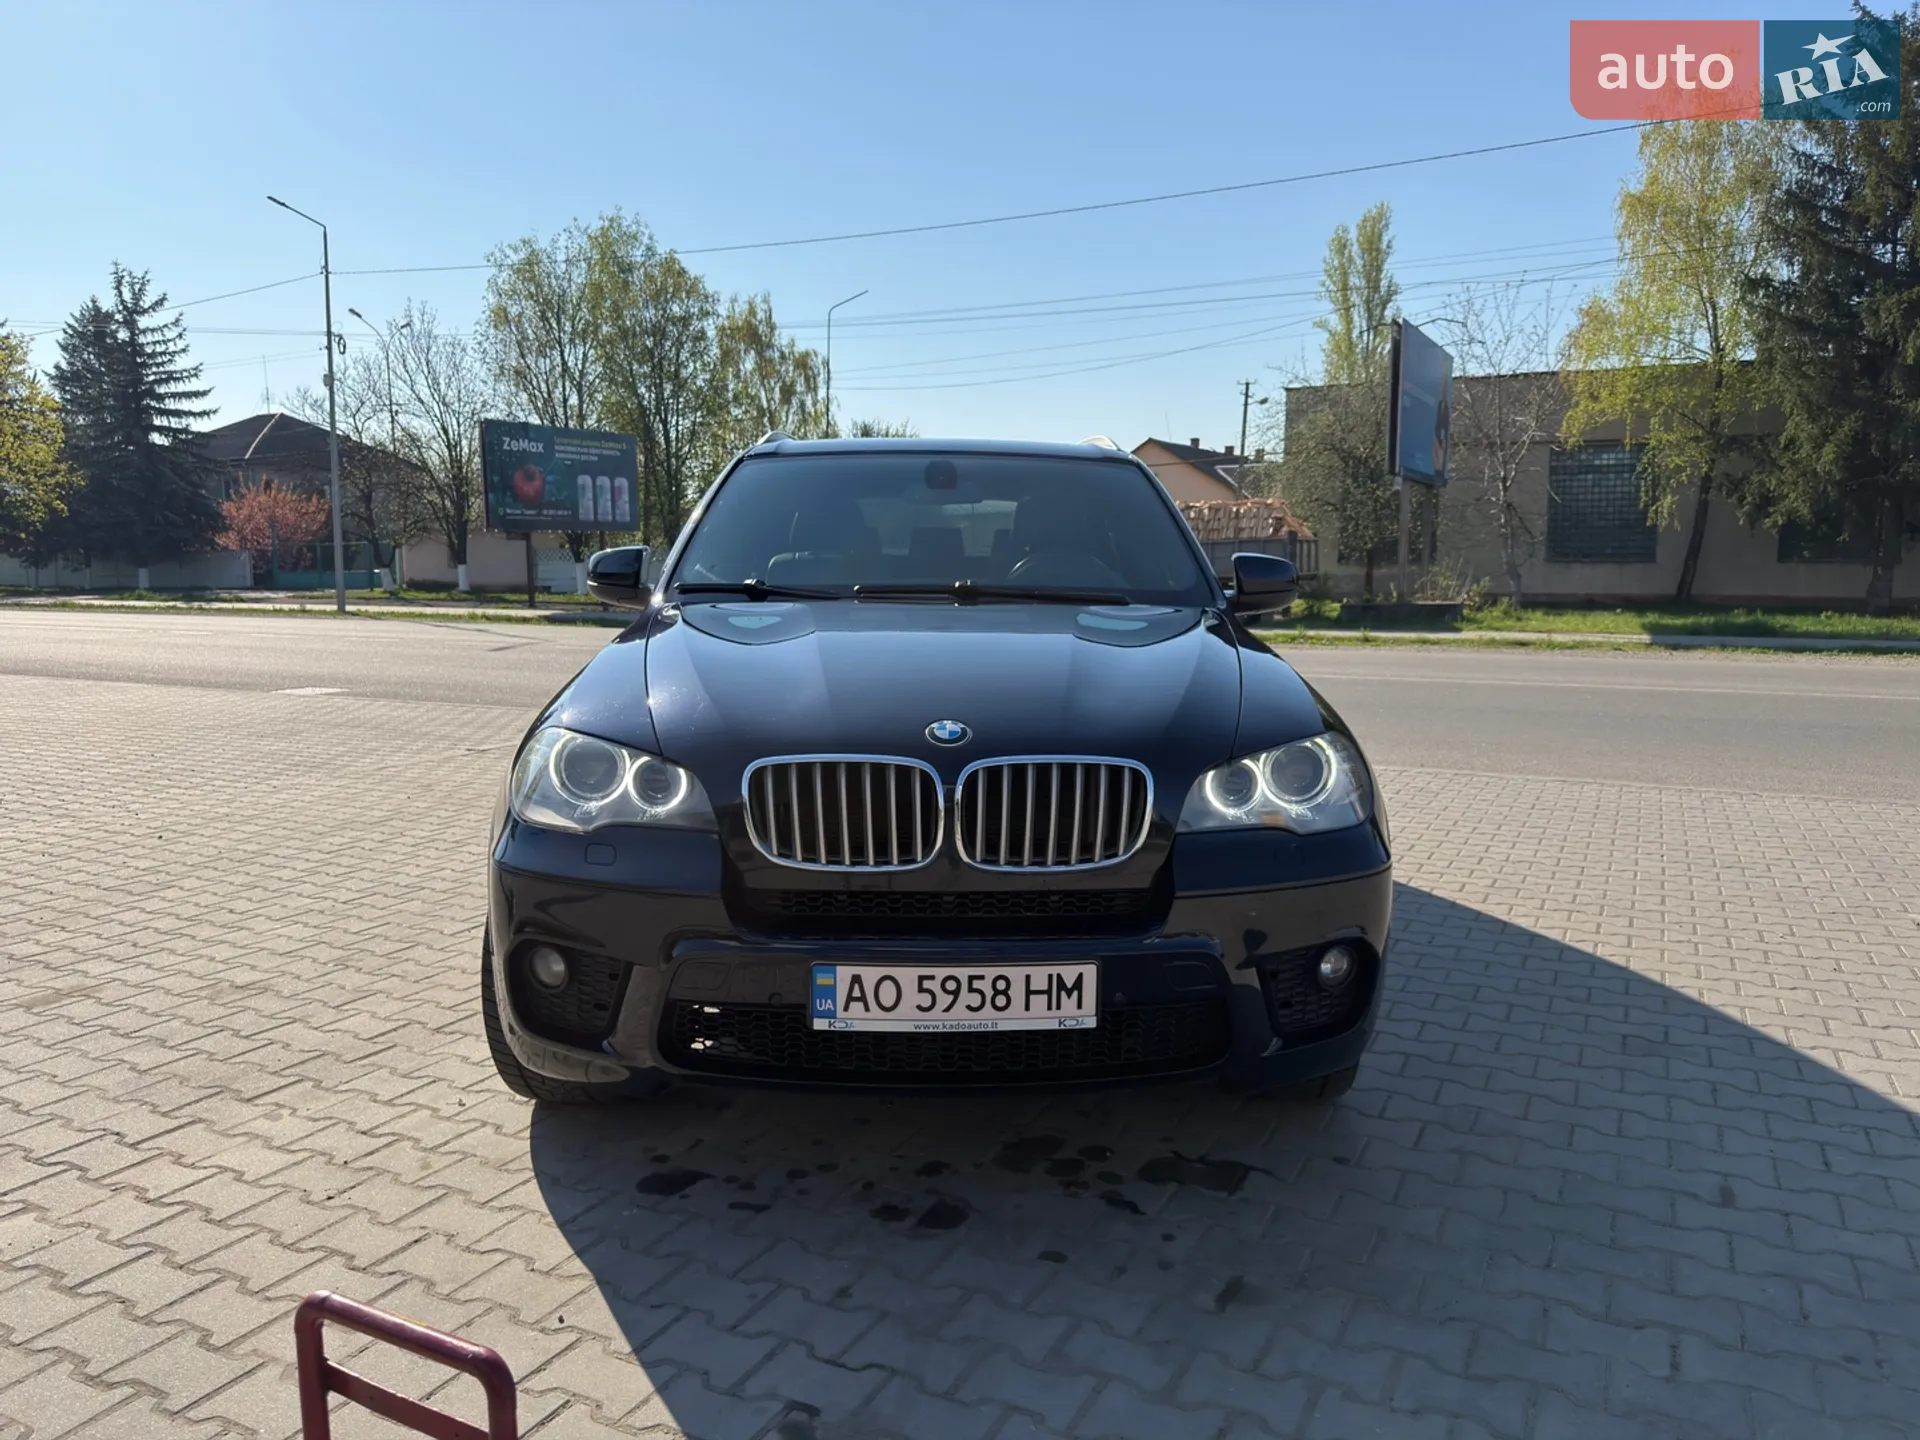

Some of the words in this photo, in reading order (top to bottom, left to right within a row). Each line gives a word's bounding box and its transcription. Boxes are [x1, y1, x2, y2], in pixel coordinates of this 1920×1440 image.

[502, 437, 544, 453] ZeMax
[842, 974, 902, 1012] AO
[915, 974, 1012, 1012] 5958
[1024, 972, 1083, 1011] HM
[816, 998, 834, 1011] UA
[913, 1021, 998, 1031] www.kadoauto.lt
